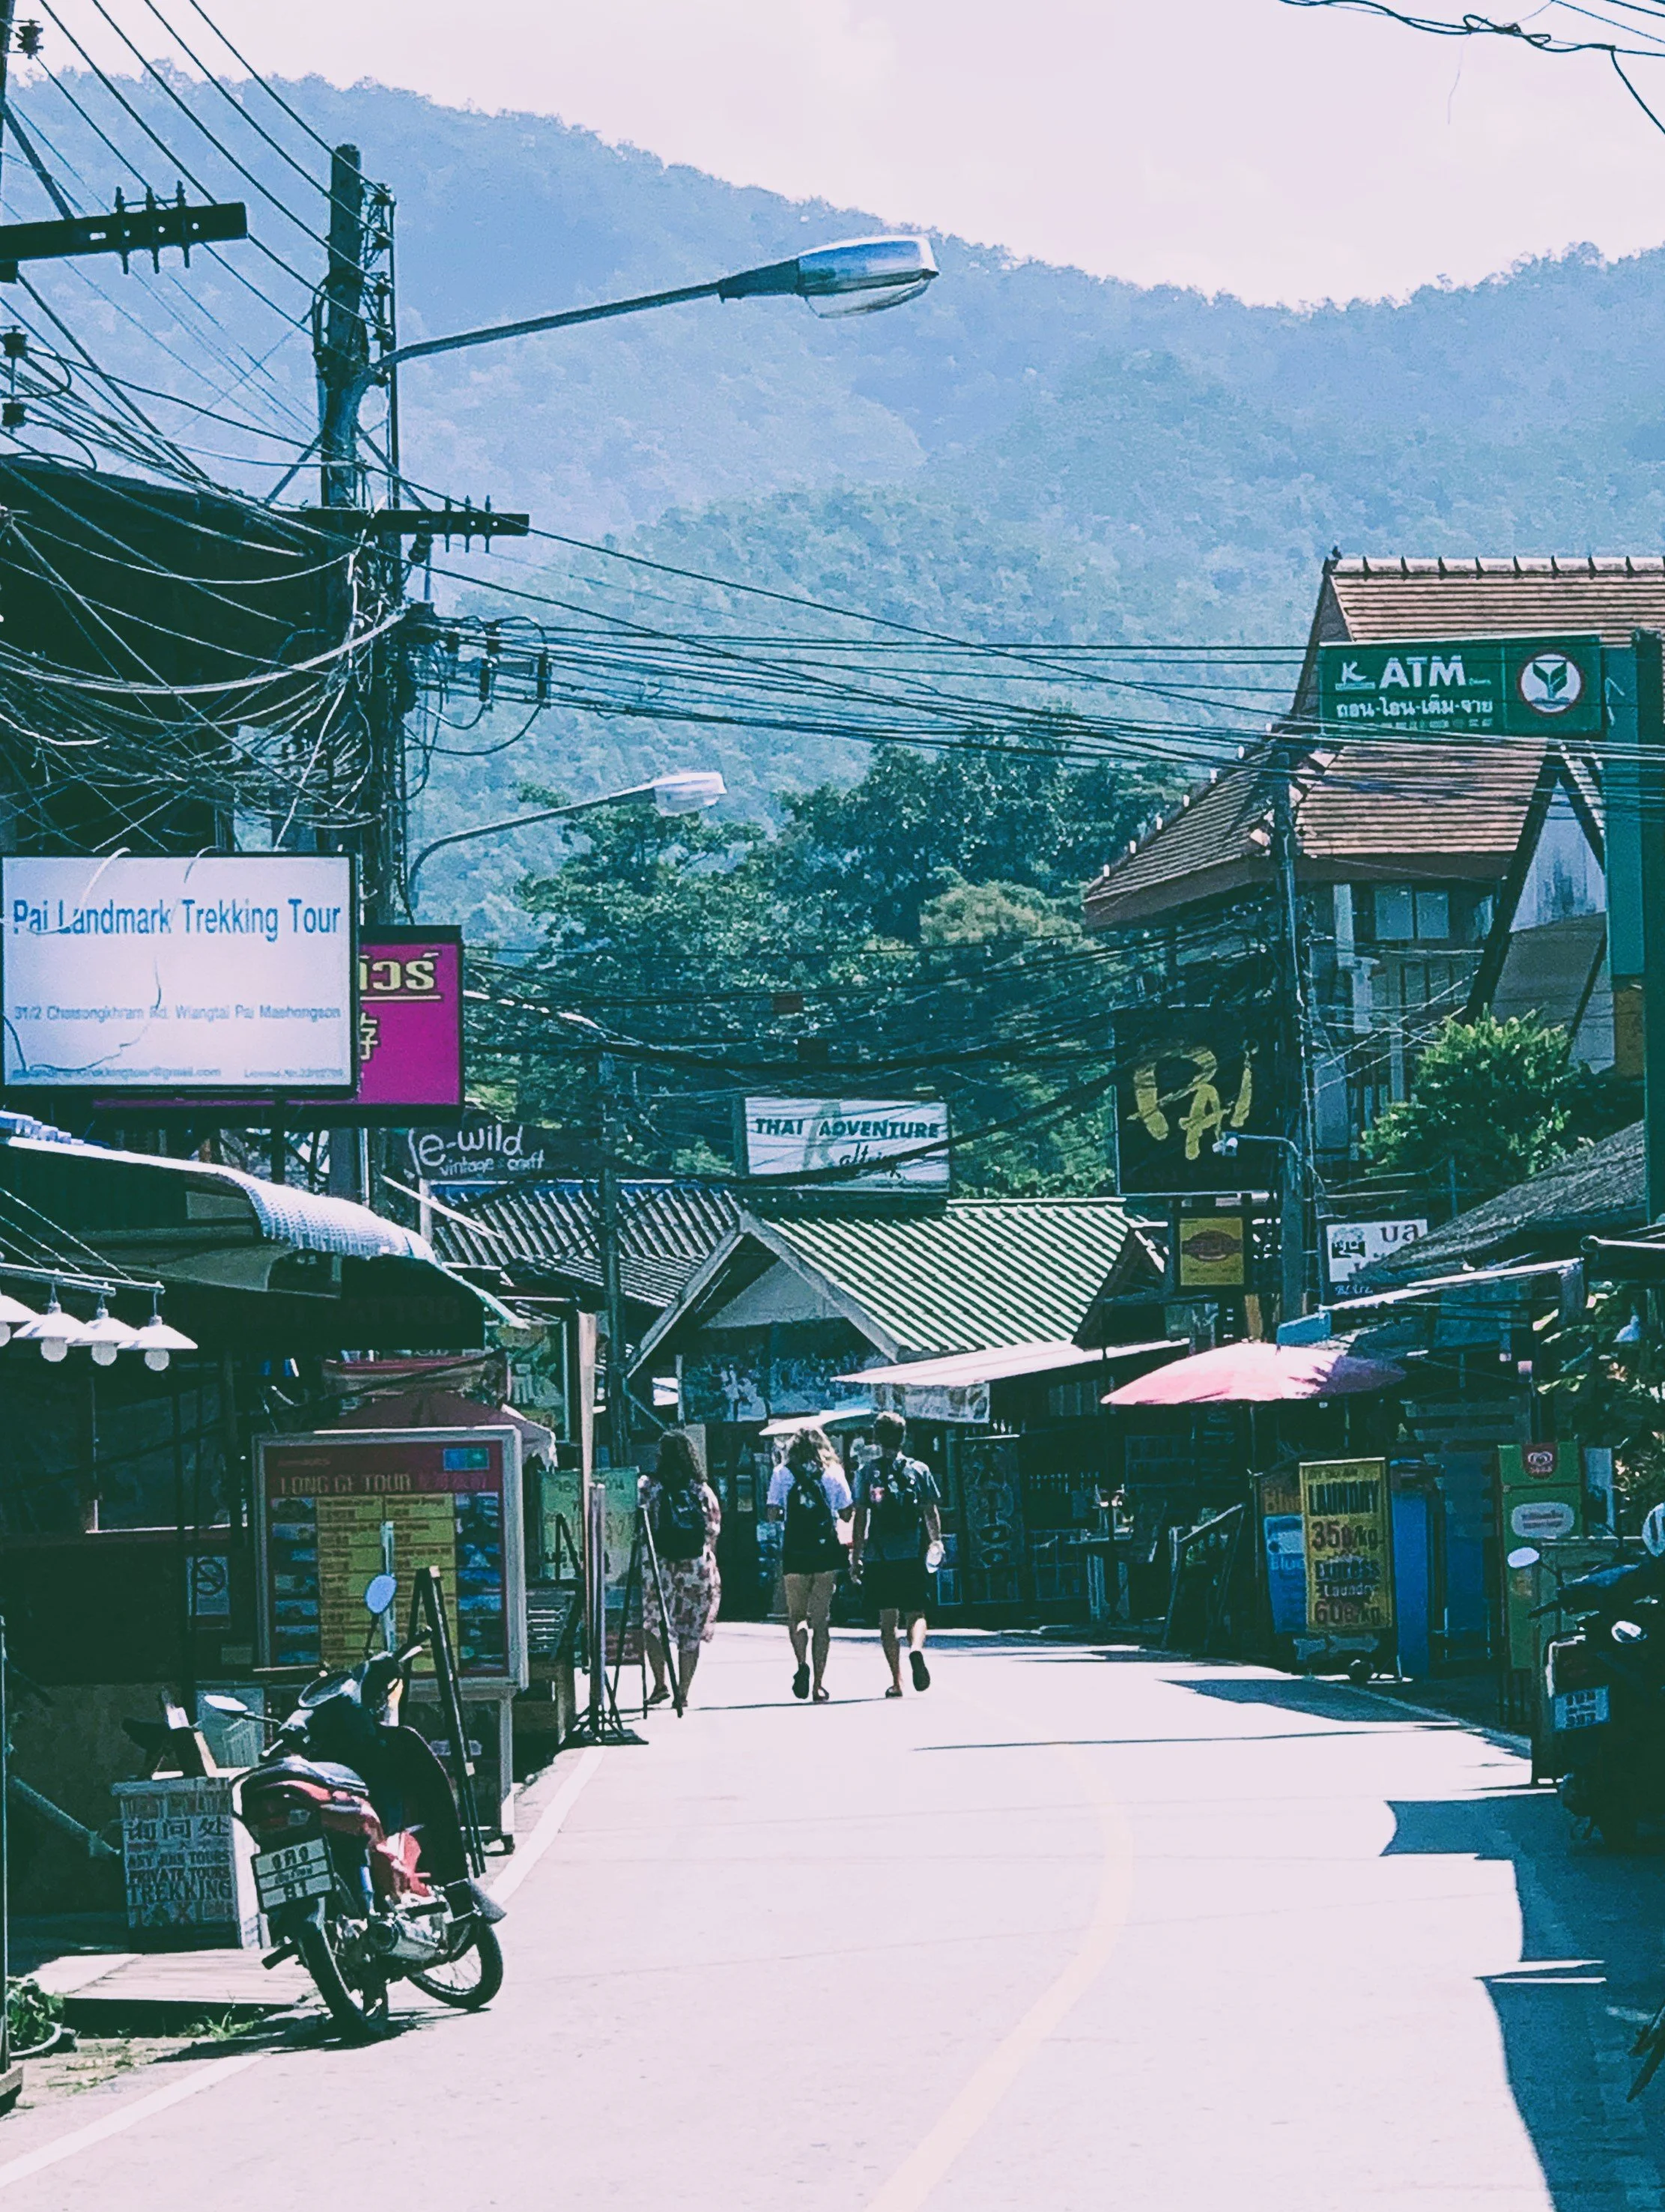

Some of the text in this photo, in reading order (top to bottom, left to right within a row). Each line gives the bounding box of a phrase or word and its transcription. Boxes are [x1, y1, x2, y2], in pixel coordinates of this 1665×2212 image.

[1379, 655, 1467, 689] ATM
[13, 898, 341, 942] Pai Landmark Trekking Tour
[755, 1118, 939, 1139] THAI ADVENTURE
[279, 1474, 329, 1495] LONG
[363, 1472, 413, 1492] TOUR
[1308, 1480, 1380, 1516] LAUNDRY
[127, 1880, 233, 1904] TREKKING
